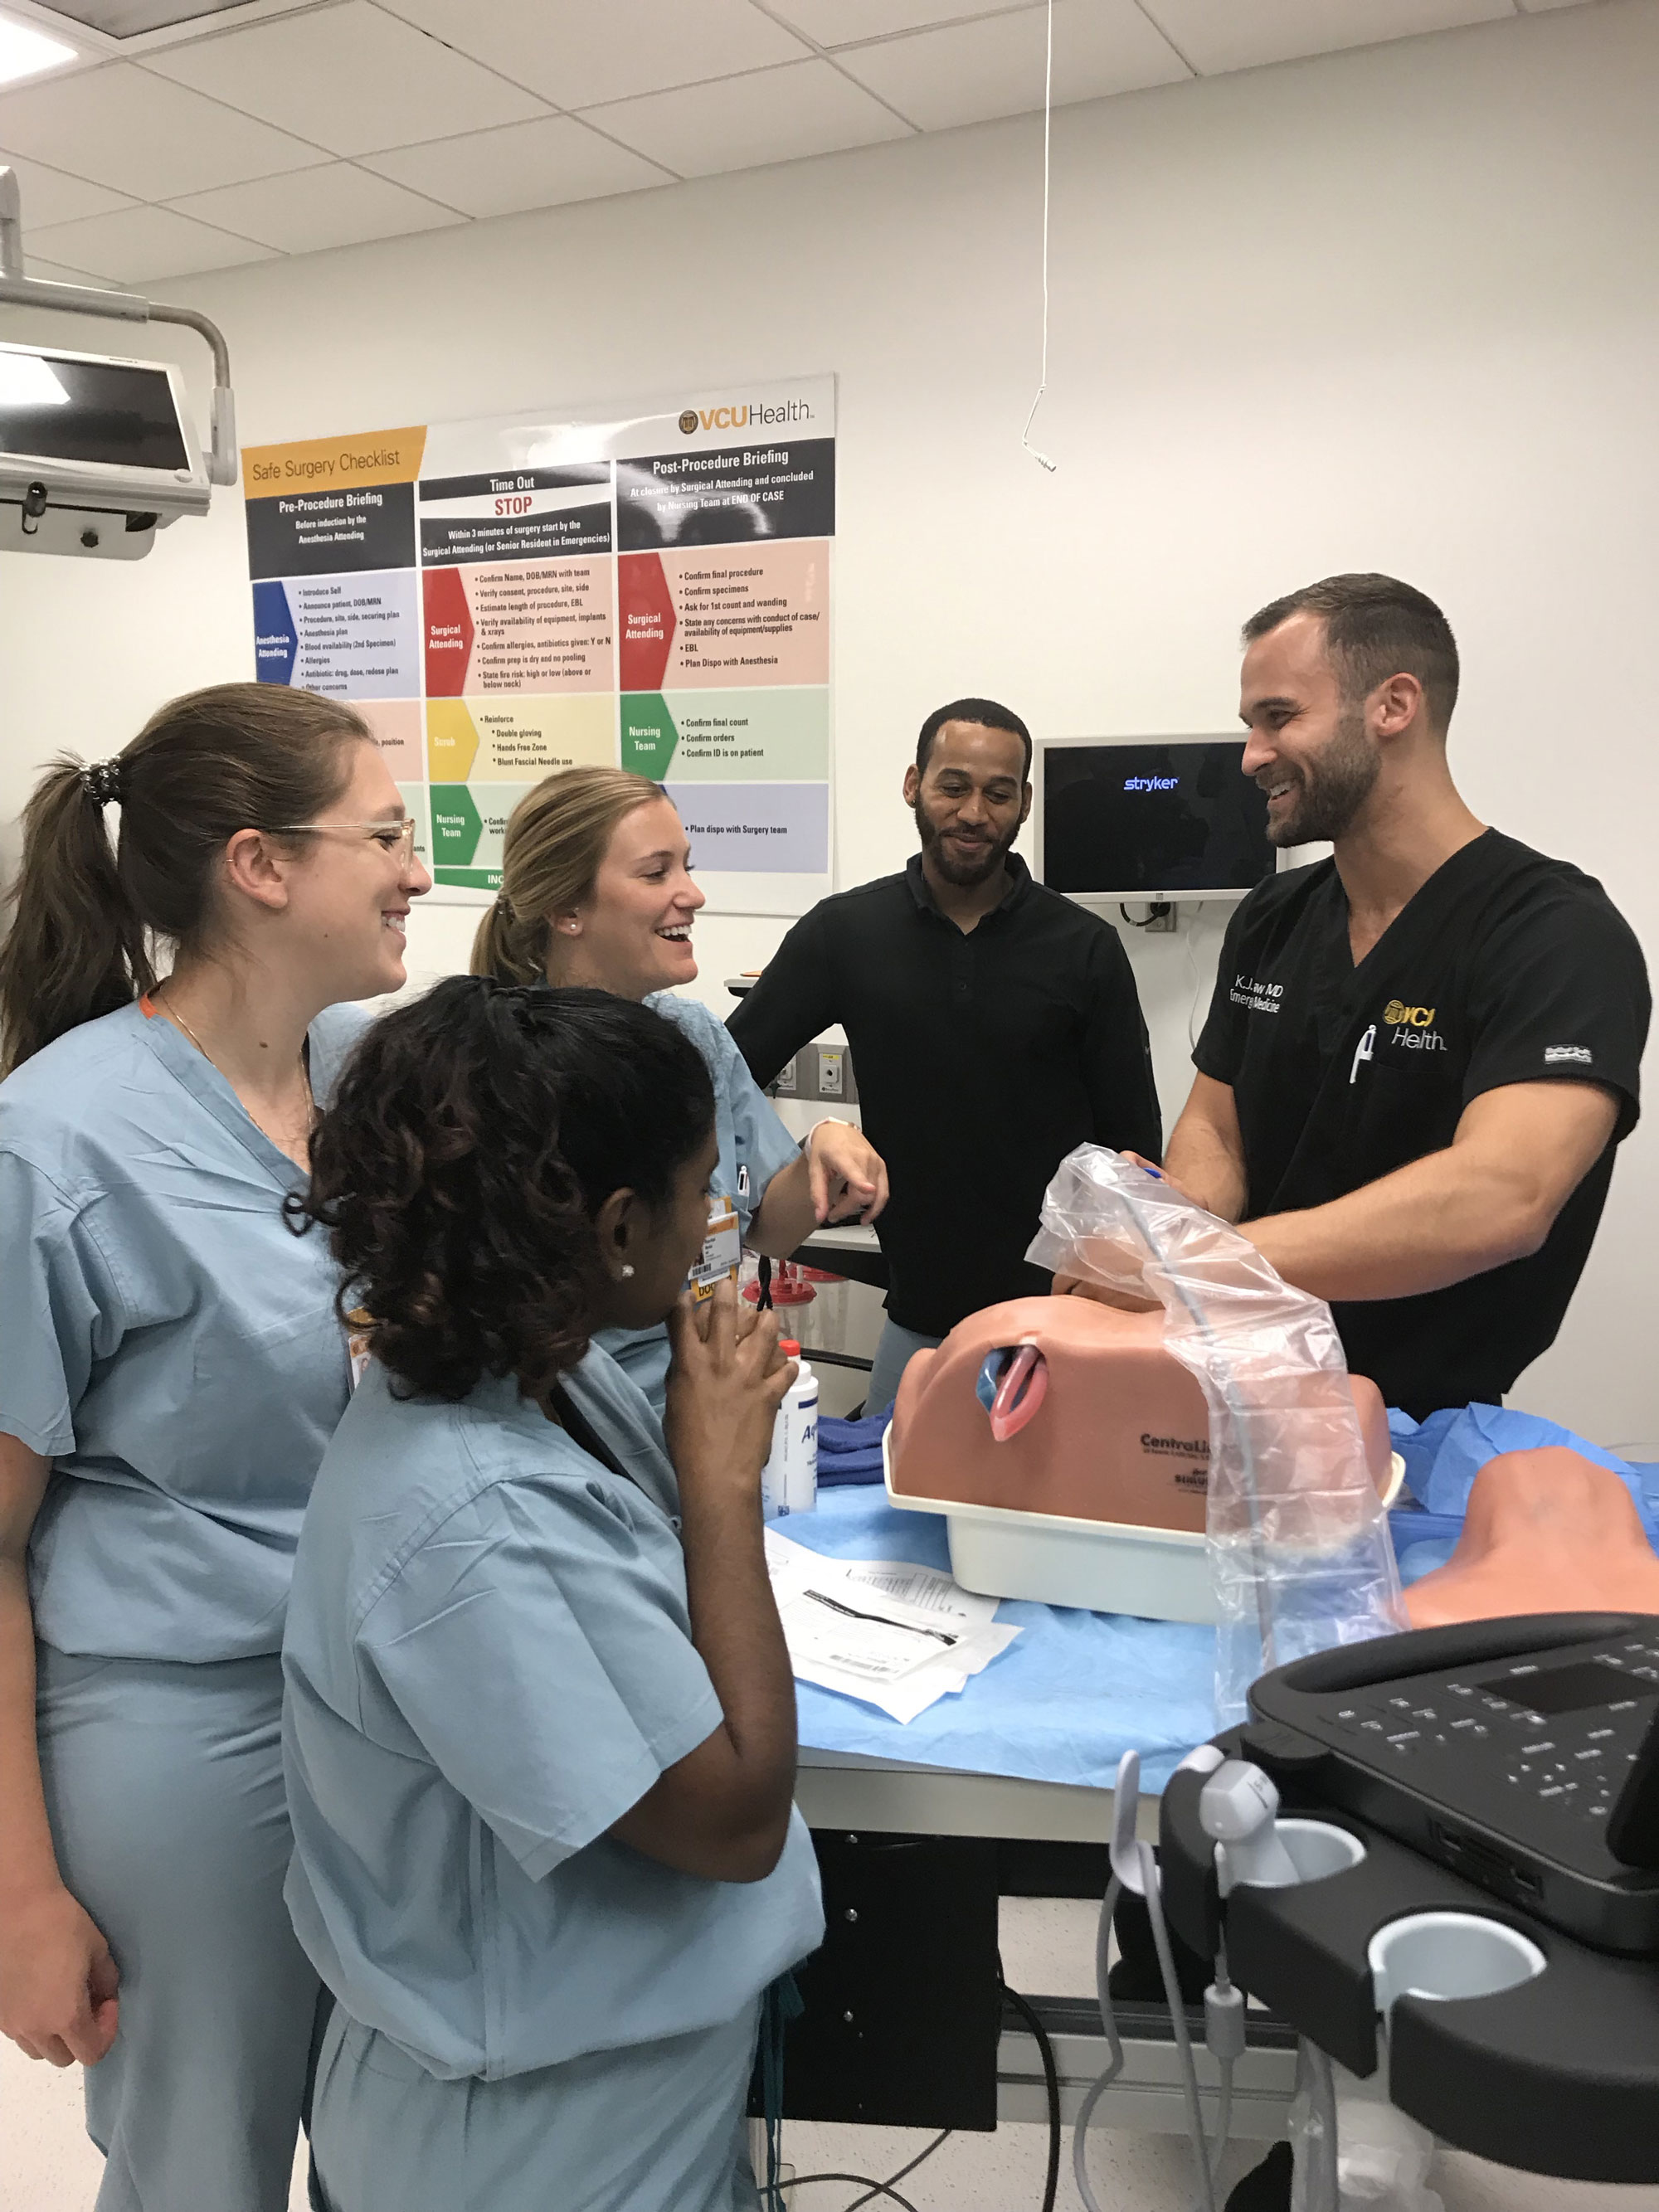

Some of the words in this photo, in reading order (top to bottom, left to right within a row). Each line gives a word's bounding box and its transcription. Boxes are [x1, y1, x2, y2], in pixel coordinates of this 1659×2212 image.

[253, 463, 281, 480] Safe
[285, 459, 335, 478] Surgery
[339, 450, 400, 471] Checklist
[654, 455, 740, 474] Post-Procedure
[743, 450, 789, 466] Briefing
[490, 479, 513, 492] Time
[517, 476, 534, 489] Out
[630, 488, 640, 498] At
[640, 487, 669, 496] closure
[670, 484, 679, 494] by
[681, 482, 713, 493] Surgical
[715, 479, 753, 489] Attending
[755, 475, 769, 484] and
[771, 470, 813, 484] concluded
[279, 496, 343, 513] Pre-Procedure
[347, 493, 382, 507] Briefing
[495, 497, 532, 515] STOP
[657, 503, 666, 512] by
[668, 500, 698, 510] Nursing
[701, 498, 720, 507] Team
[732, 494, 748, 504] END
[751, 493, 761, 503] OF
[762, 490, 784, 501] CASE
[295, 520, 316, 529] Before
[317, 518, 346, 527] induction
[348, 517, 355, 527] by
[356, 515, 366, 523] the
[448, 529, 470, 539] Within
[472, 529, 476, 537] 3
[478, 527, 504, 537] minutes
[506, 526, 513, 534] of
[514, 524, 541, 535] surgery
[542, 523, 558, 532] start
[560, 522, 568, 532] by
[570, 520, 581, 528] the
[299, 535, 333, 544] Anesthesia
[334, 532, 364, 541] Attending
[423, 547, 450, 557] Surgical
[452, 543, 484, 554] Attending
[485, 542, 494, 552] (or
[497, 541, 520, 551] Senior
[522, 538, 552, 548] Resident
[553, 537, 559, 546] in
[562, 533, 610, 546] Emergencies)
[504, 573, 525, 581] Name,
[526, 571, 557, 580] DOB/MRN
[713, 571, 727, 579] final
[728, 568, 763, 579] procedure
[480, 589, 498, 598] Verify
[499, 588, 526, 596] consent,
[528, 586, 559, 596] procedure,
[713, 586, 748, 596] specimens
[304, 601, 330, 610] Announce
[354, 598, 382, 606] DOB/MRN
[480, 604, 507, 612] Estimate
[508, 603, 528, 611] length
[530, 601, 536, 610] of
[538, 600, 569, 610] procedure,
[699, 602, 709, 610] for
[722, 600, 742, 609] count
[743, 600, 755, 608] and
[757, 598, 787, 608] wanding
[480, 618, 499, 627] Verify
[500, 616, 535, 625] availability
[537, 615, 542, 624] of
[543, 615, 577, 624] equipment,
[579, 613, 606, 622] implants
[628, 613, 661, 625] Surgical
[685, 618, 702, 627] State
[703, 619, 714, 627] any
[747, 615, 761, 624] with
[763, 614, 790, 622] conduct
[791, 613, 798, 621] of
[800, 612, 820, 621] case/
[431, 625, 460, 636] Surgical
[625, 630, 664, 639] Attending
[684, 627, 720, 637] availability
[722, 626, 728, 635] of
[729, 624, 792, 635] equipment/supplies
[256, 634, 289, 644] Anesthesia
[430, 639, 464, 649] Attending
[259, 648, 288, 658] Attending
[482, 657, 505, 665] Confirm
[507, 656, 522, 665] prep
[523, 655, 528, 664] is
[529, 655, 539, 664] dry
[541, 654, 552, 663] and
[562, 654, 586, 663] pooling
[685, 659, 701, 668] Plan
[703, 659, 722, 668] Dispo
[740, 656, 777, 664] Anesthesia
[713, 718, 728, 727] final
[497, 729, 518, 737] Double
[519, 728, 542, 738] gloving
[630, 727, 660, 737] Nursing
[686, 734, 712, 742] Confirm
[434, 737, 455, 746] Scrub
[497, 743, 516, 751] Hands
[532, 743, 547, 751] Zone
[635, 741, 655, 751] Team
[686, 749, 712, 757] Confirm
[740, 749, 764, 758] patient
[498, 757, 513, 766] Blunt
[515, 757, 537, 766] Fascial
[538, 757, 560, 766] Needle
[1124, 776, 1178, 791] stryker
[436, 814, 465, 826] Nursing
[441, 828, 460, 837] Team
[707, 825, 725, 834] dispo
[743, 825, 768, 834] Surgery
[488, 875, 504, 883] INC
[1265, 984, 1283, 997] MD
[1230, 989, 1253, 1009] Emerg
[1141, 1433, 1210, 1453] CentraLi
